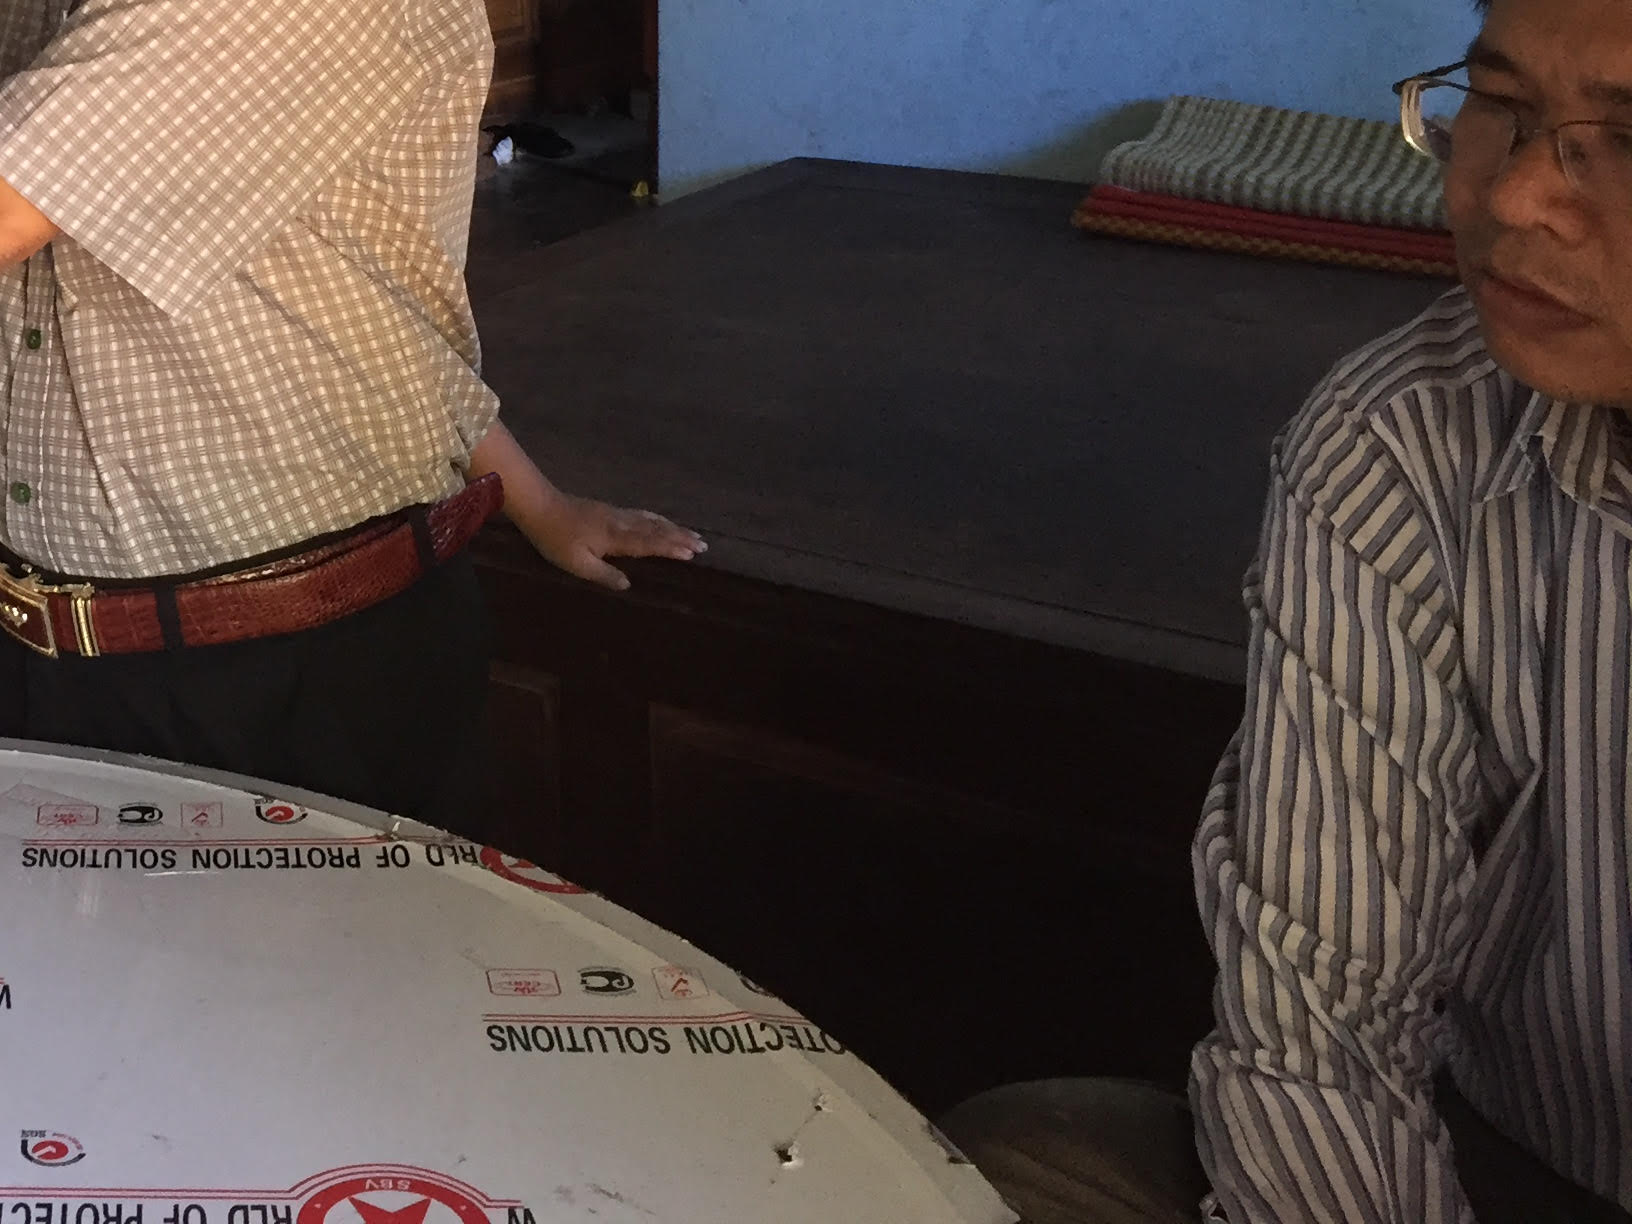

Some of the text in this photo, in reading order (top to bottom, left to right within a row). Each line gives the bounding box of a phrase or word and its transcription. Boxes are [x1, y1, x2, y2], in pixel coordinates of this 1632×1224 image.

[21, 847, 178, 869] SOLUTIONS
[191, 844, 362, 870] PROTECTION
[375, 844, 411, 869] OF
[485, 1023, 671, 1055] SOLUTIONS
